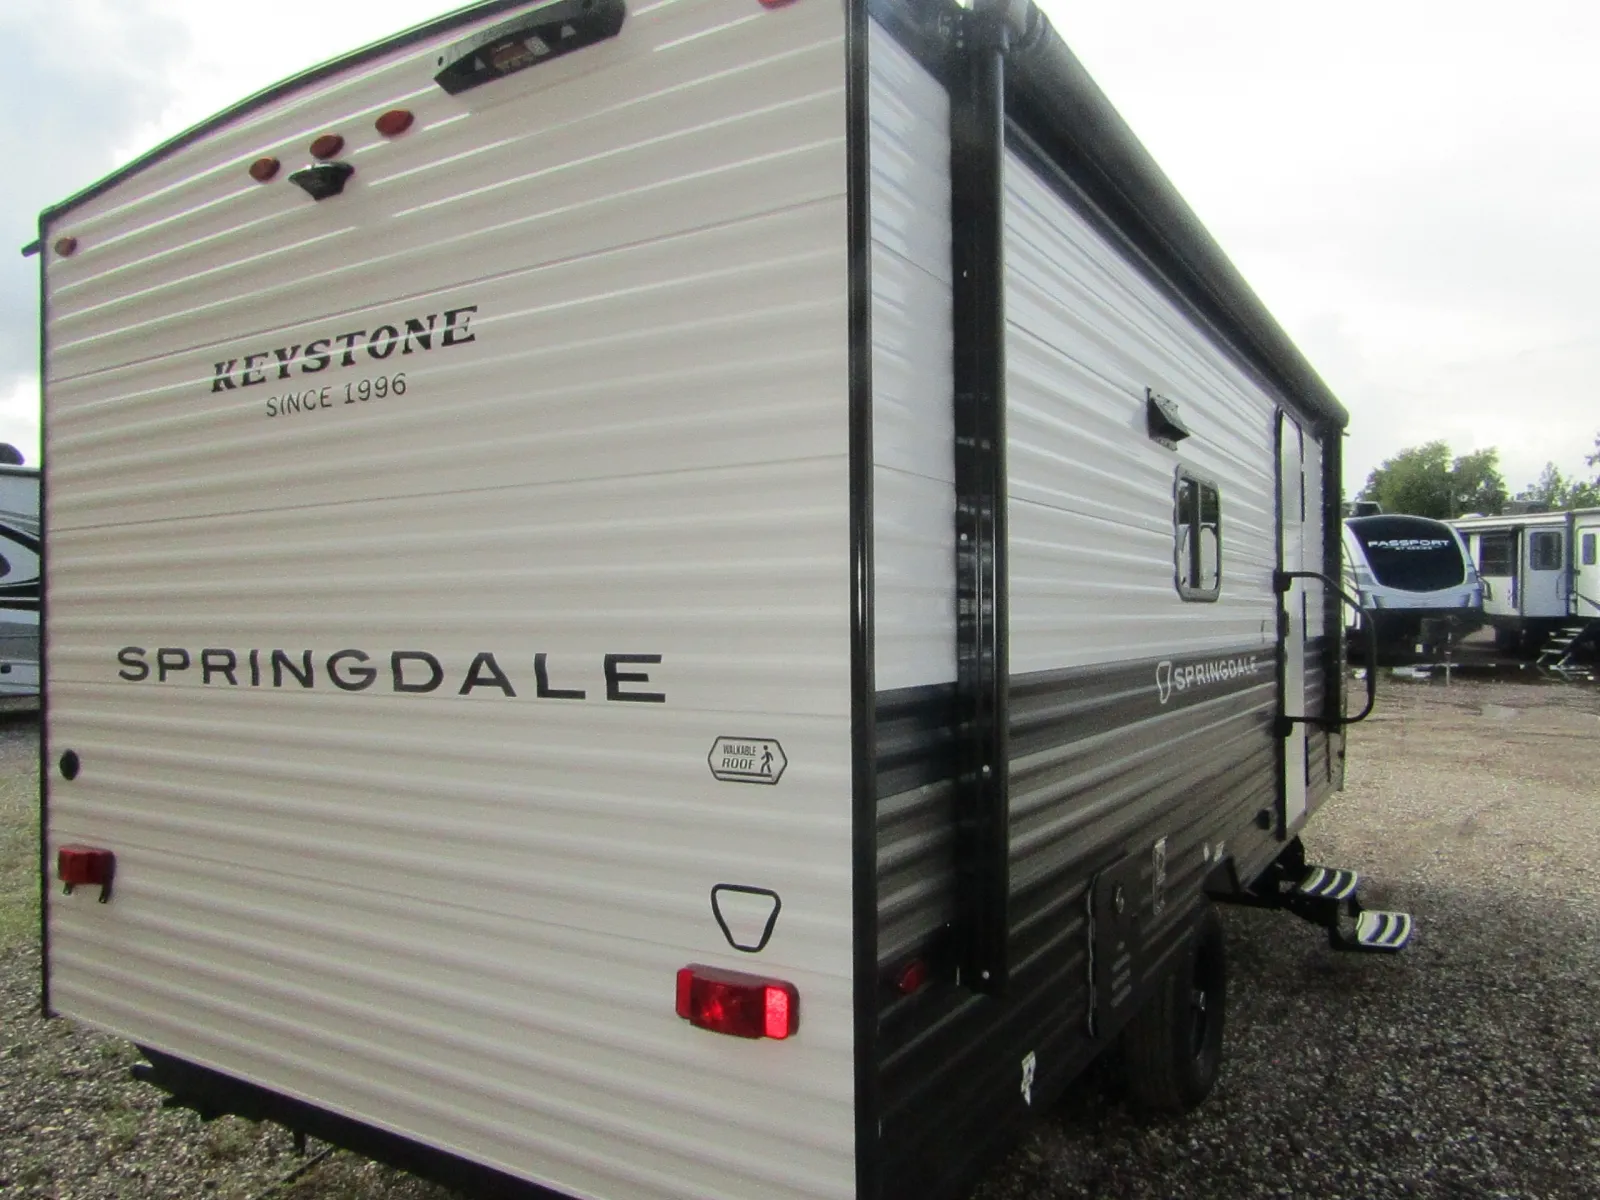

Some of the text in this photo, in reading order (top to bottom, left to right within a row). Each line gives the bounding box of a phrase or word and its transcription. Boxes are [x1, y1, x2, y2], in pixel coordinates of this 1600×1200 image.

[211, 305, 478, 393] KEYSTONE
[266, 372, 407, 417] SINCE 1996
[1367, 539, 1449, 548] PASSPORT
[117, 645, 667, 703] SPRINGDALE
[1174, 656, 1258, 690] SPRINGDALE
[722, 757, 756, 769] ROOF
[723, 744, 757, 756] WALKABLE
